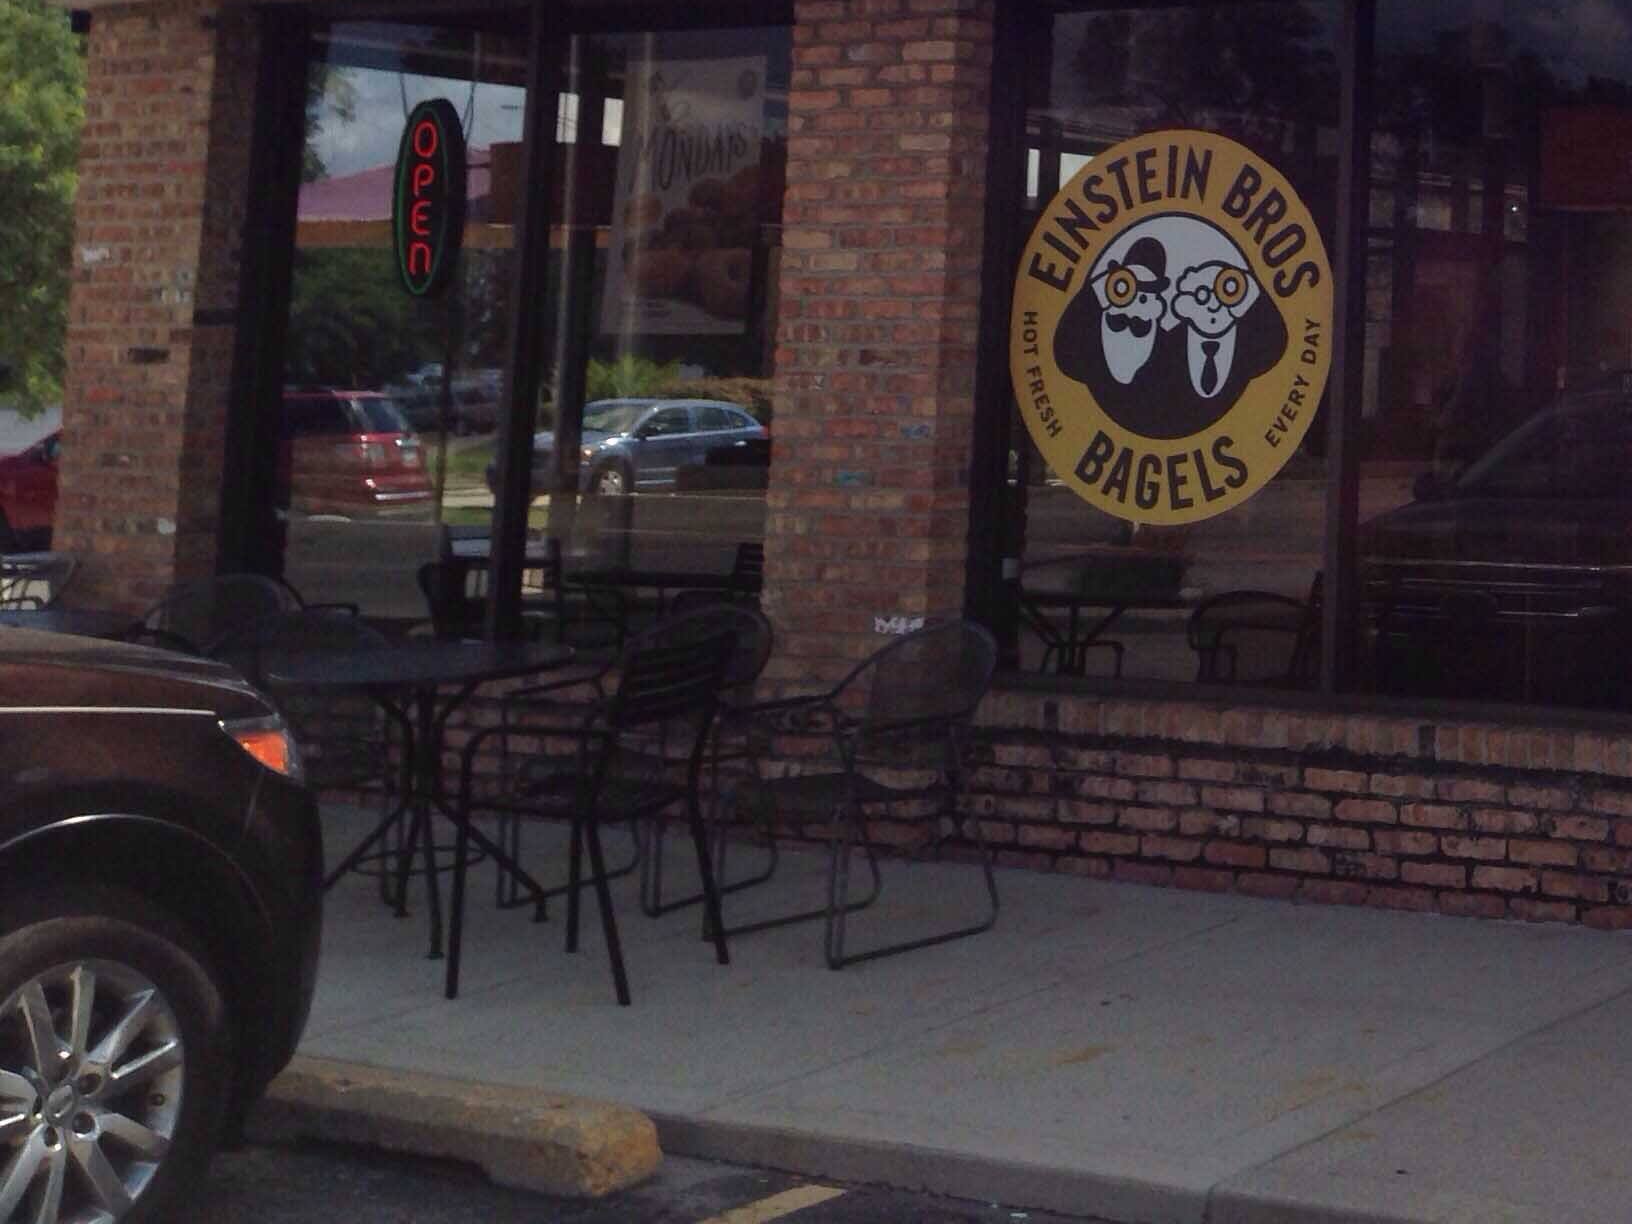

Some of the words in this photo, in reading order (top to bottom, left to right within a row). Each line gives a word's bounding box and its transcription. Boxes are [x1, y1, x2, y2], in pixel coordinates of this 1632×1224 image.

[1028, 144, 1214, 293] EINSTEIN
[1220, 163, 1321, 299] BROS
[1023, 311, 1038, 356] HOT
[1026, 366, 1063, 438] FRESH
[1265, 374, 1311, 448] EVERY
[1298, 318, 1322, 366] DAY
[1074, 430, 1249, 511] BAGELS
